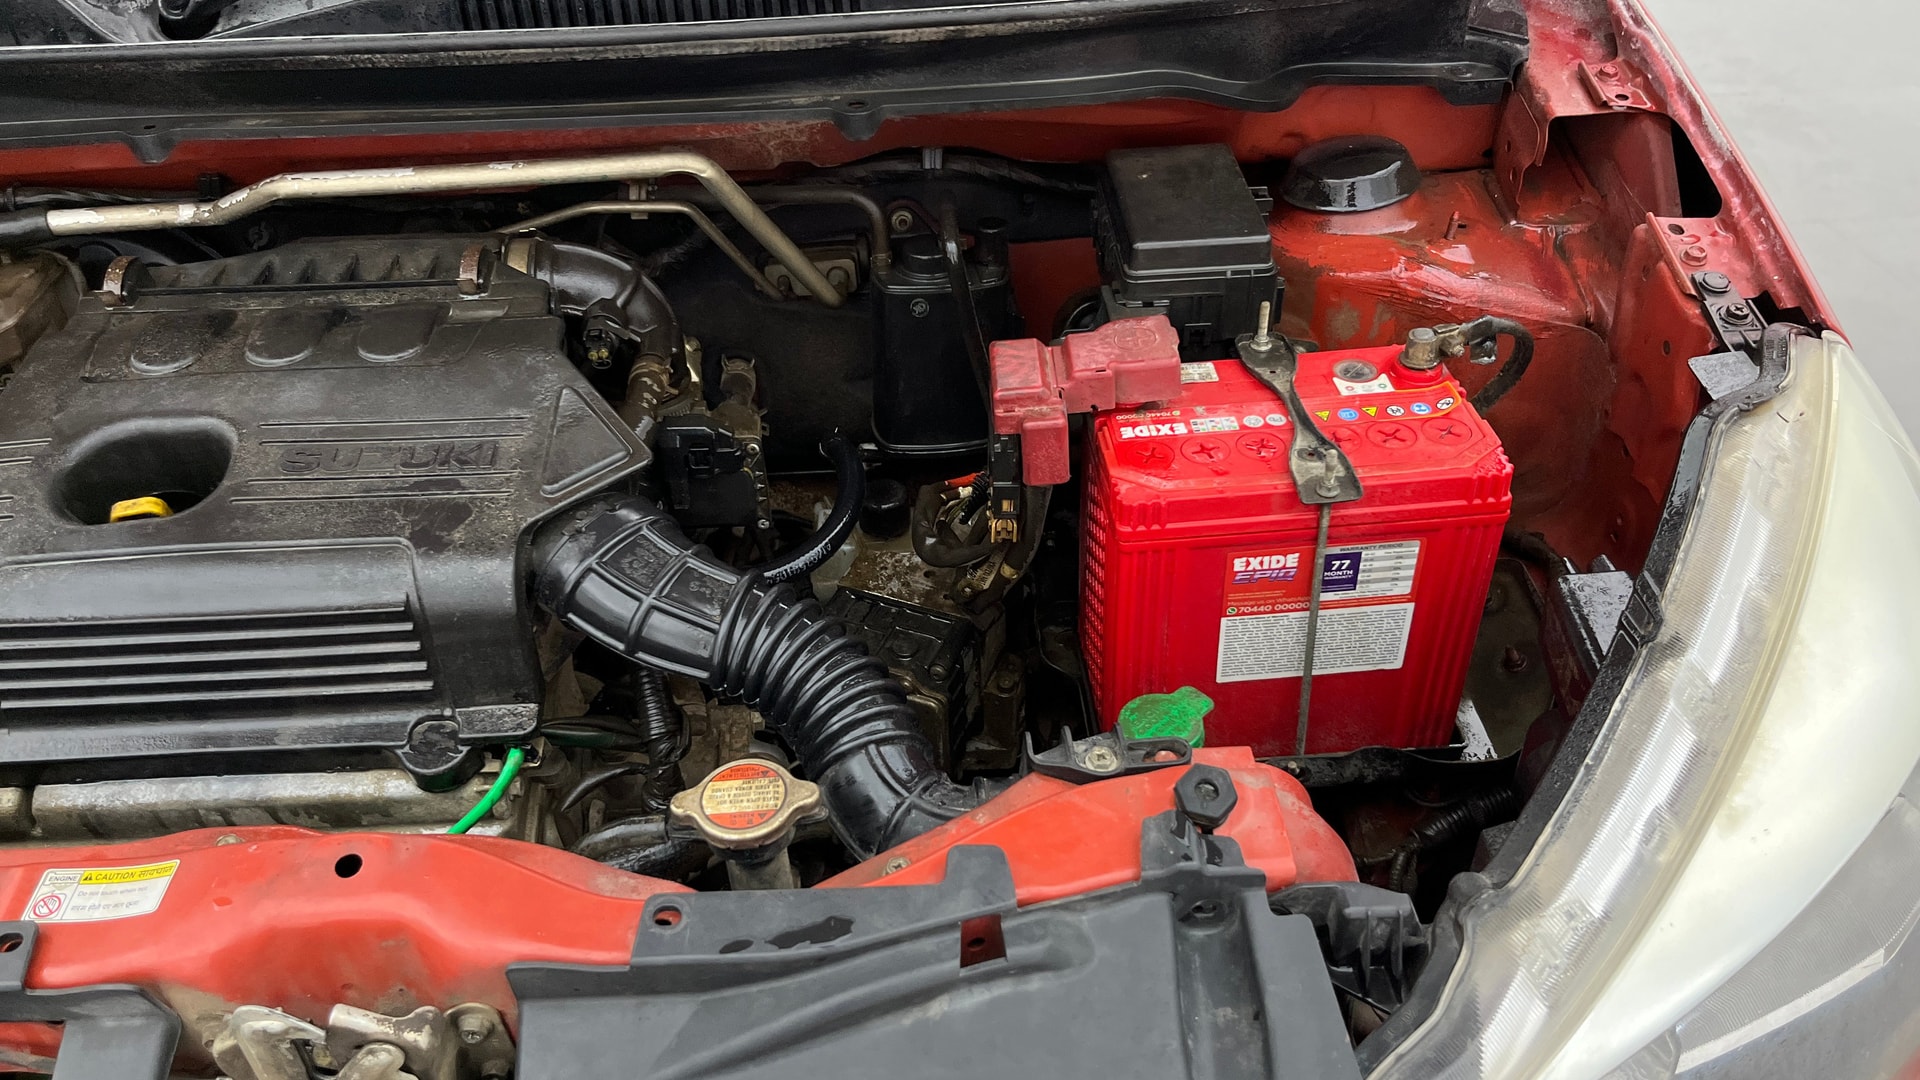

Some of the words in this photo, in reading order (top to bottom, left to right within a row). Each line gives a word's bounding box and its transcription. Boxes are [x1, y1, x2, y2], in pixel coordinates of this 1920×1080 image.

[1119, 422, 1188, 439] EXIDE
[280, 444, 498, 472] SUZUKI
[1233, 553, 1300, 572] EXIDE
[1331, 560, 1351, 570] 77
[1232, 569, 1298, 584] EPIQ
[1324, 569, 1353, 577] MONTH
[1238, 605, 1272, 613] 70440
[1274, 601, 1310, 611] 00000
[95, 871, 136, 881] CAUTION
